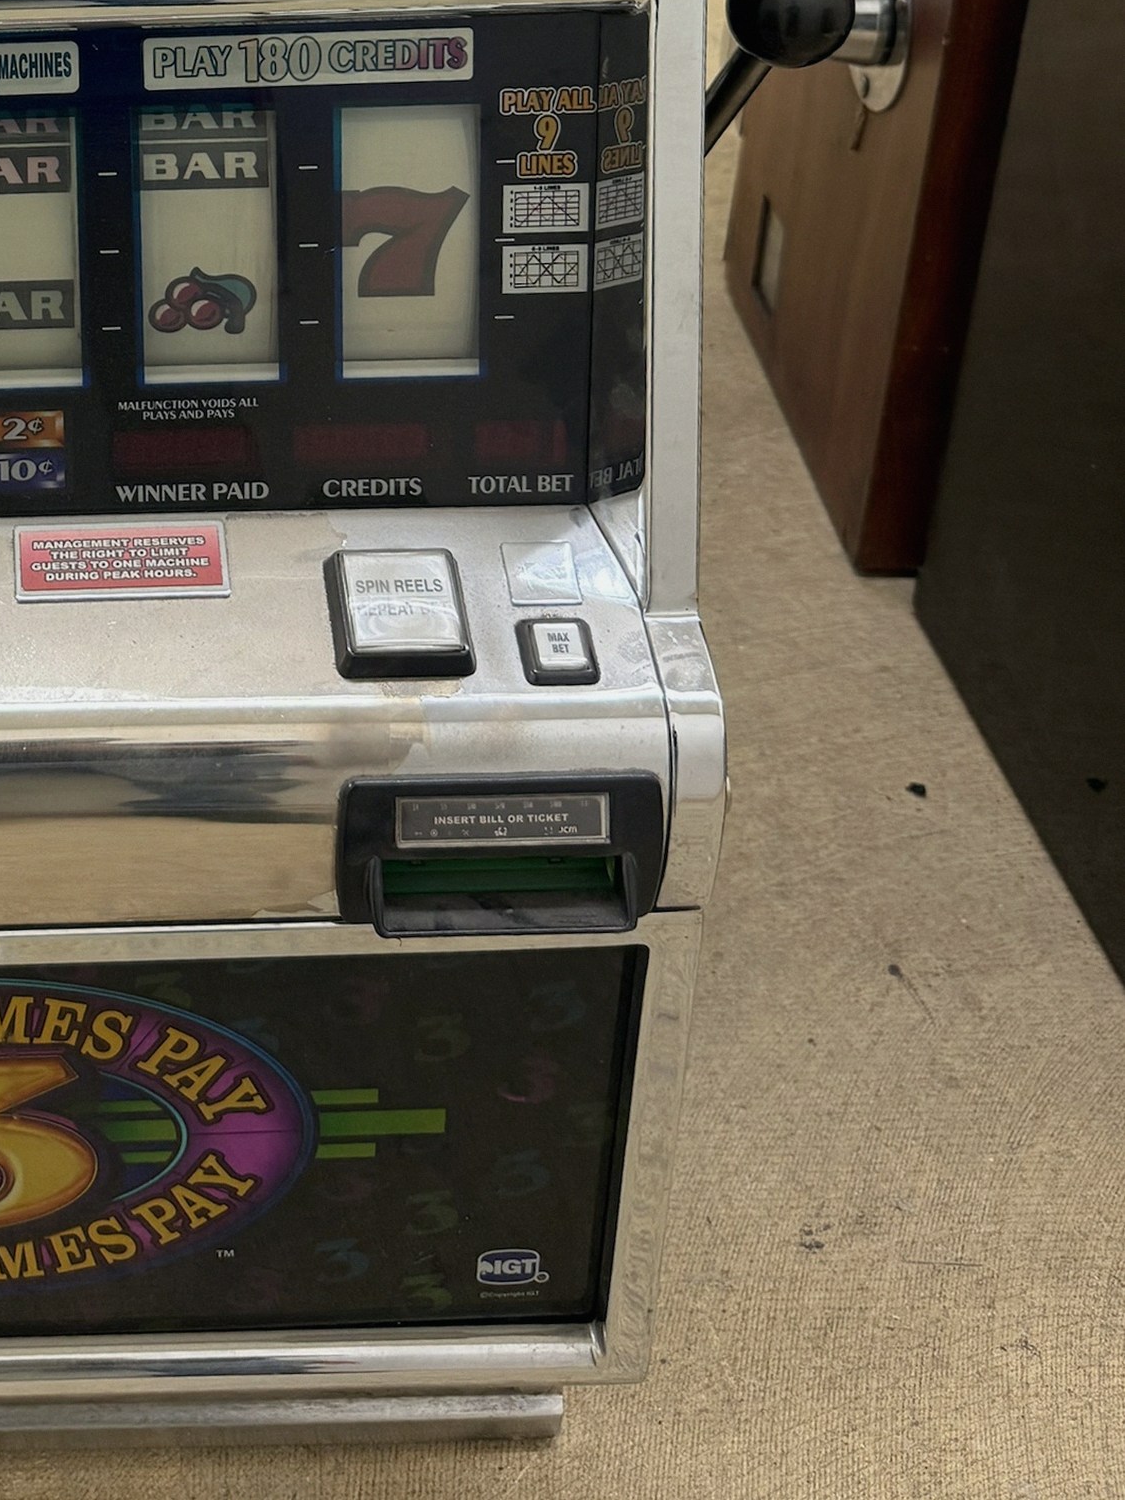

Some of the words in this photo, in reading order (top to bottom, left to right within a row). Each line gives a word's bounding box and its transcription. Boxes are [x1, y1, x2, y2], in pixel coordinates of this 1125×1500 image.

[152, 44, 232, 79] PLAY
[237, 36, 322, 83] 180
[327, 36, 468, 73] CREDITS
[322, 477, 422, 498] CREDITS
[468, 474, 532, 494] TOTAL
[537, 474, 574, 492] BET
[115, 483, 207, 503] WINNER
[213, 481, 269, 501] PAID
[32, 538, 130, 550] MANAGEMENT
[134, 536, 205, 547] RESERVES
[51, 550, 78, 560] THE
[82, 549, 124, 559] RIGHT
[129, 549, 147, 558] TO
[150, 547, 189, 557] LIMIT
[31, 561, 87, 571] GUESTS
[91, 560, 110, 570] TO
[113, 559, 142, 569] ONE
[145, 557, 209, 568] MACHINE
[45, 571, 99, 582] DURING
[103, 570, 141, 580] PEAK
[144, 568, 197, 579] HOURS.
[355, 579, 390, 594] SPIN
[394, 578, 444, 593] REELS
[547, 632, 570, 642] MAX
[552, 643, 570, 654] BET
[434, 815, 475, 825] INSERT
[479, 814, 504, 824] BILL
[507, 814, 524, 823] OR
[527, 812, 569, 823] TICKET
[136, 1026, 269, 1123] PAY
[133, 1153, 254, 1244] PAY
